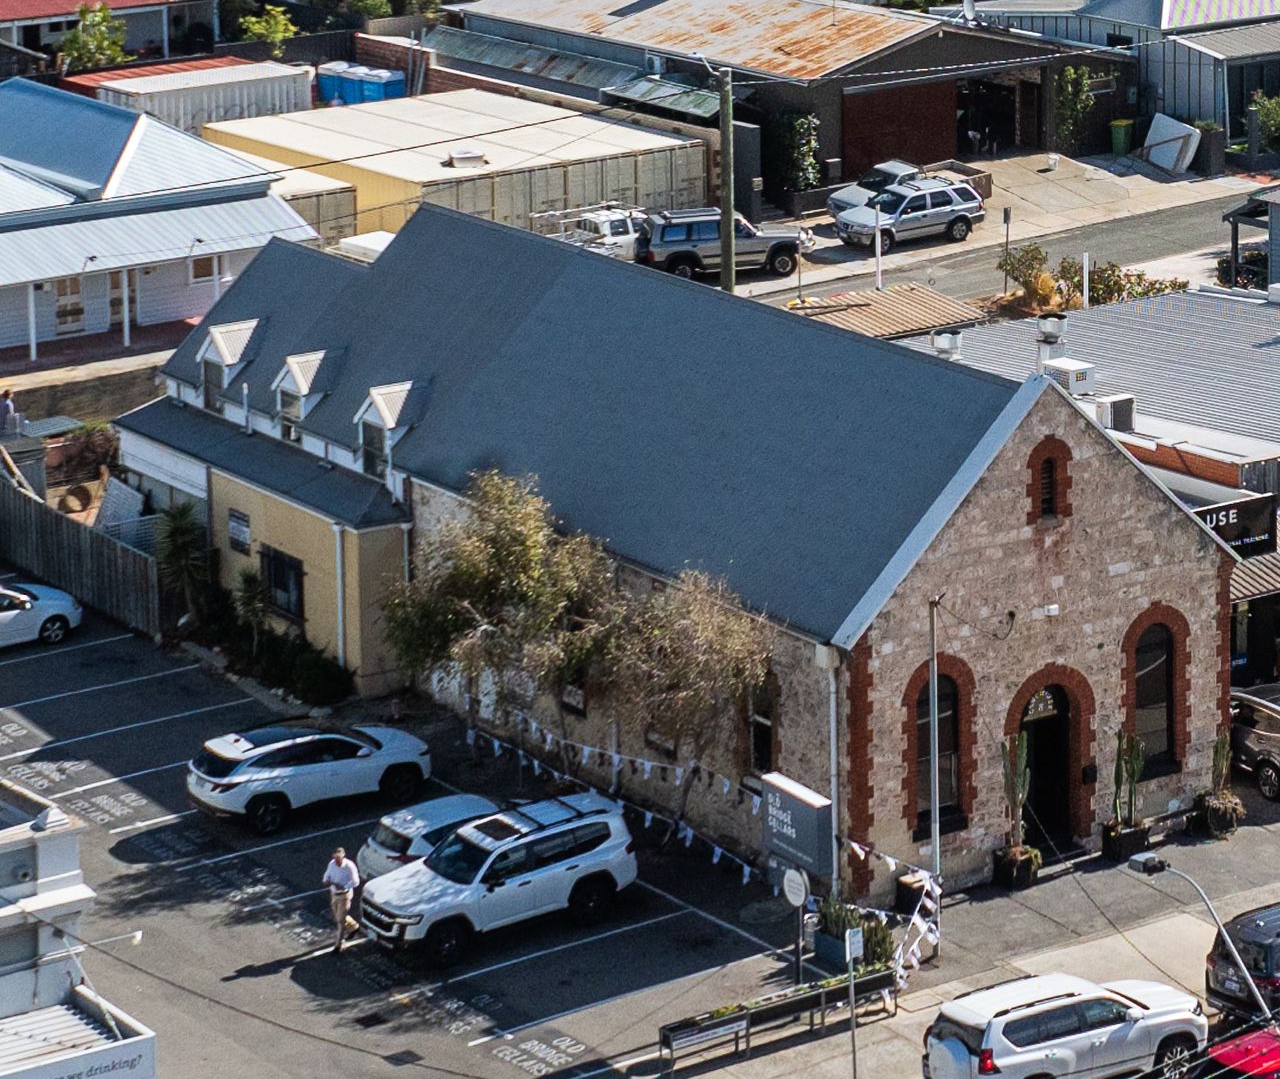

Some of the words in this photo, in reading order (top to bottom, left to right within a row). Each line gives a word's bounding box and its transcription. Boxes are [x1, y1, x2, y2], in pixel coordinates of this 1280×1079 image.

[519, 1039, 573, 1066] BRIDGE
[552, 1036, 586, 1054] OLD
[86, 1054, 143, 1078] drinking?
[492, 1045, 554, 1077] CELLARS
